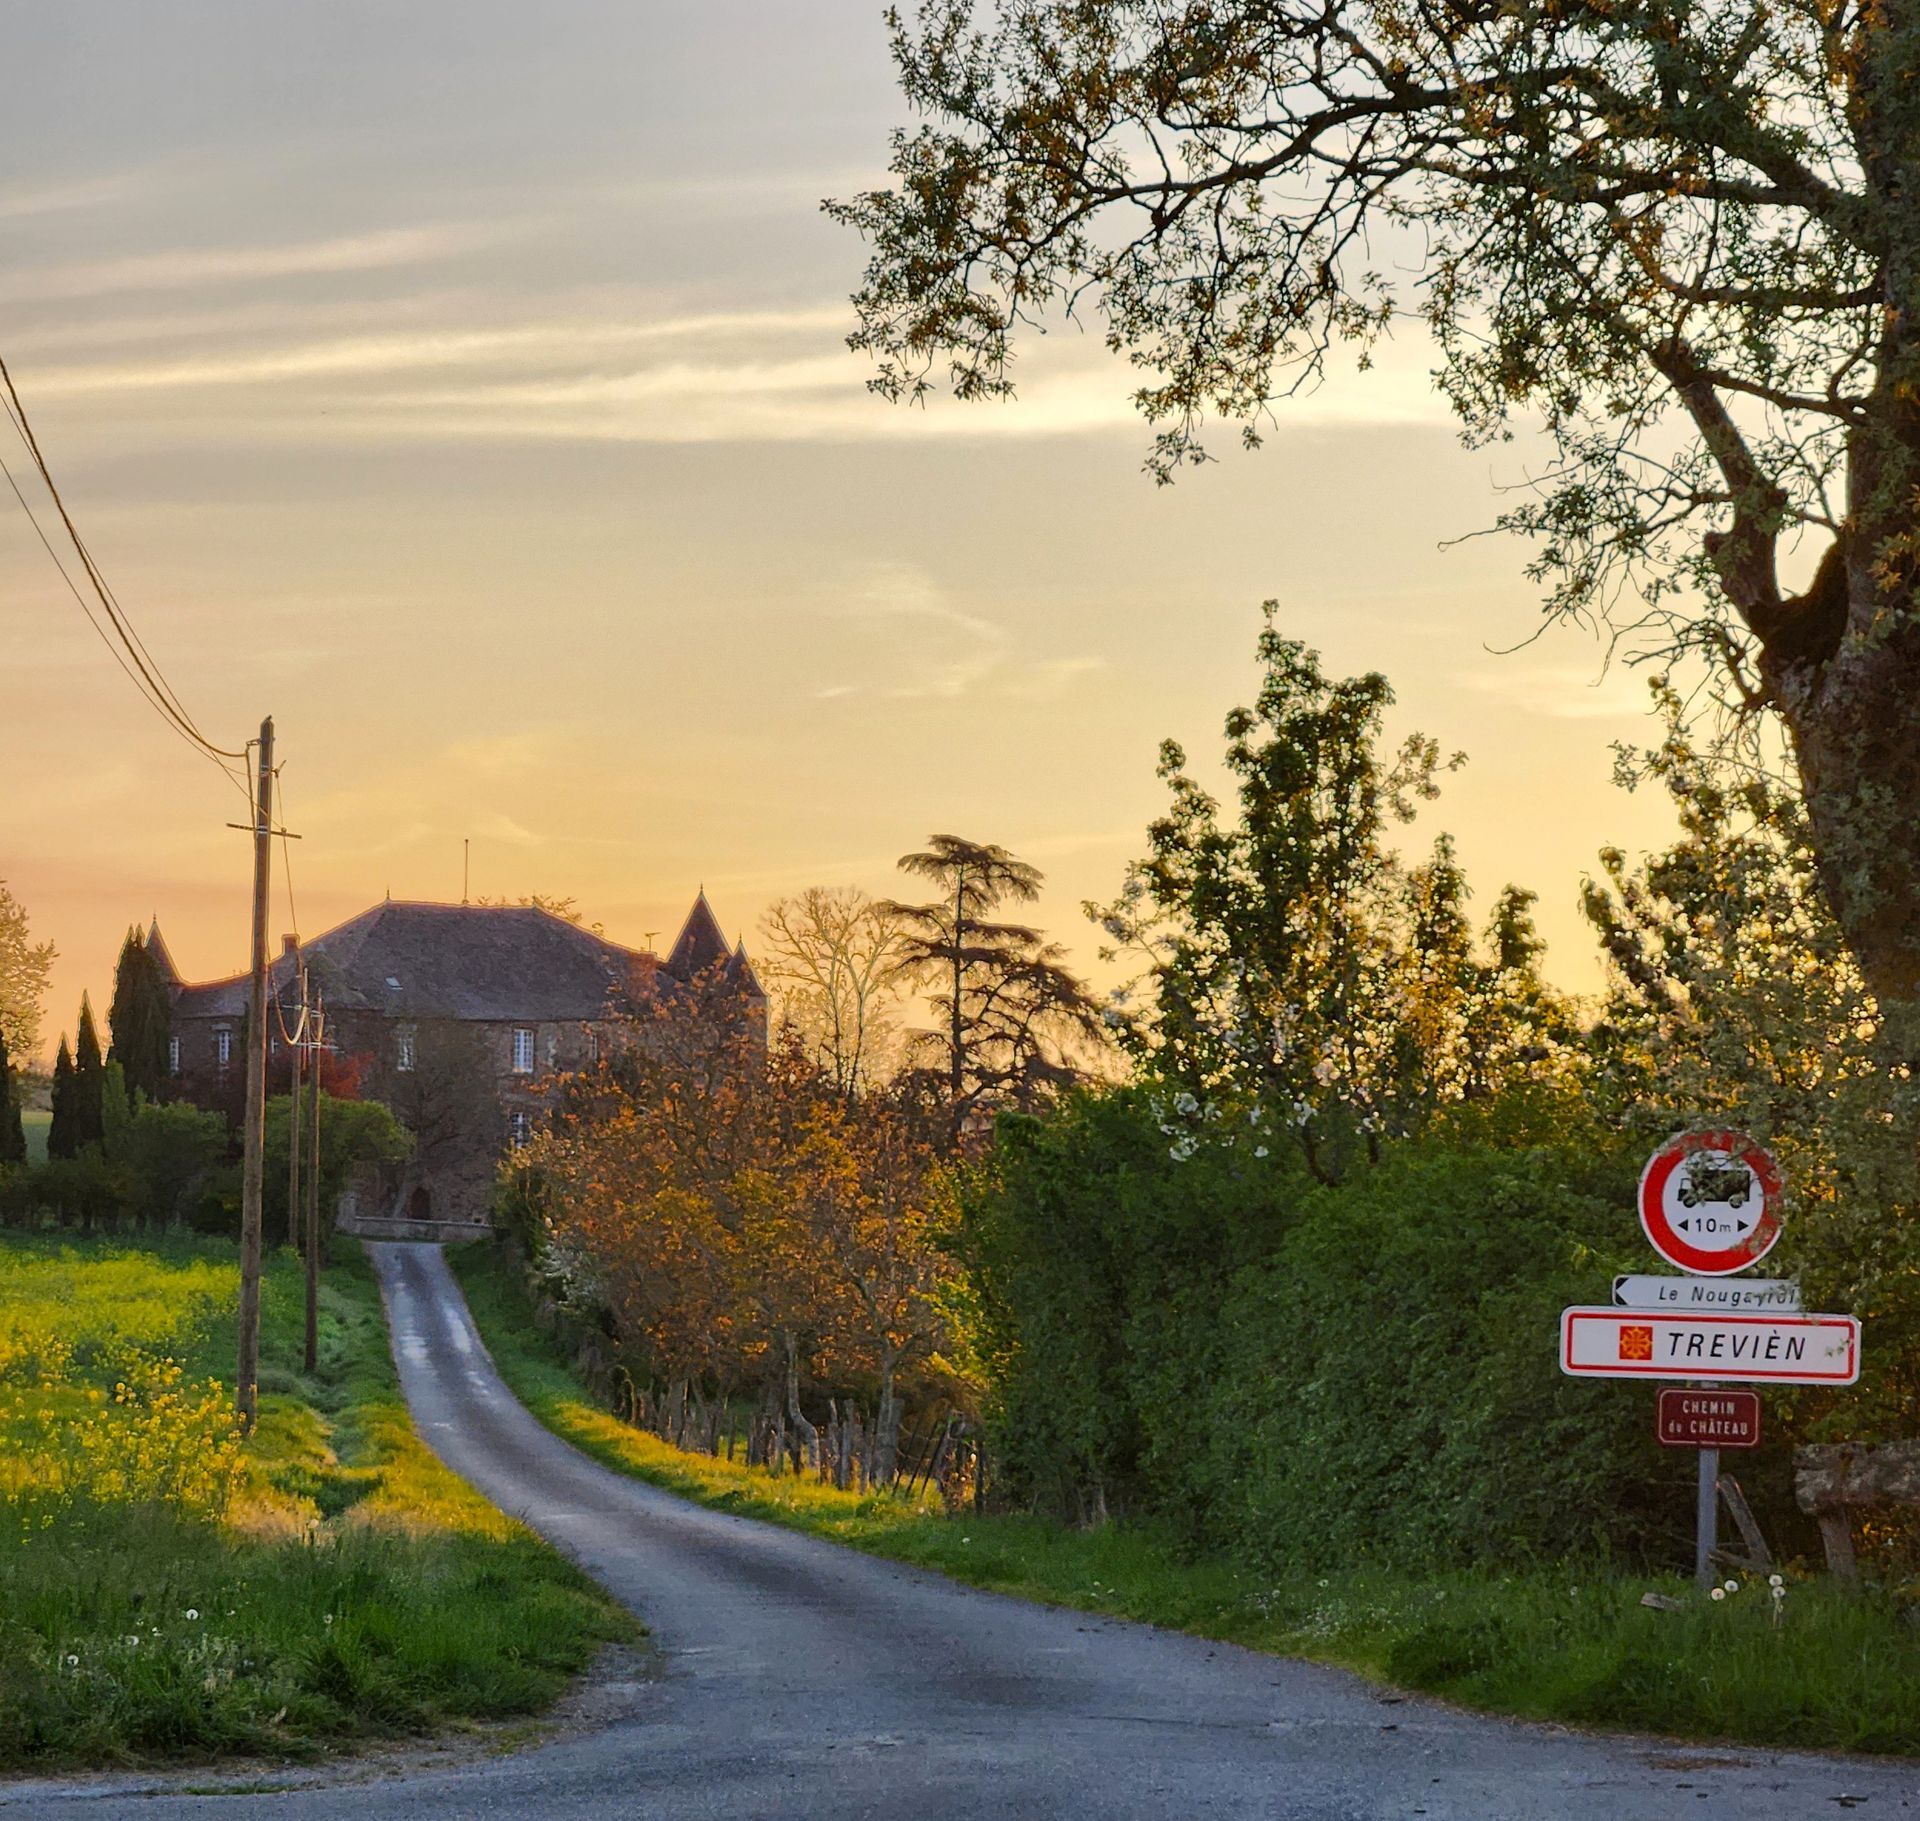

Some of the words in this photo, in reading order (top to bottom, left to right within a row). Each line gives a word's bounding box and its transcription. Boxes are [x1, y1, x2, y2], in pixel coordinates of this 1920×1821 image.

[1659, 1285, 1678, 1301] Le
[1668, 1330, 1806, 1360] TREVIÈN
[1682, 1400, 1735, 1414] CHEMIN
[1668, 1422, 1682, 1434] du
[1690, 1418, 1748, 1435] CHÂTEAU
